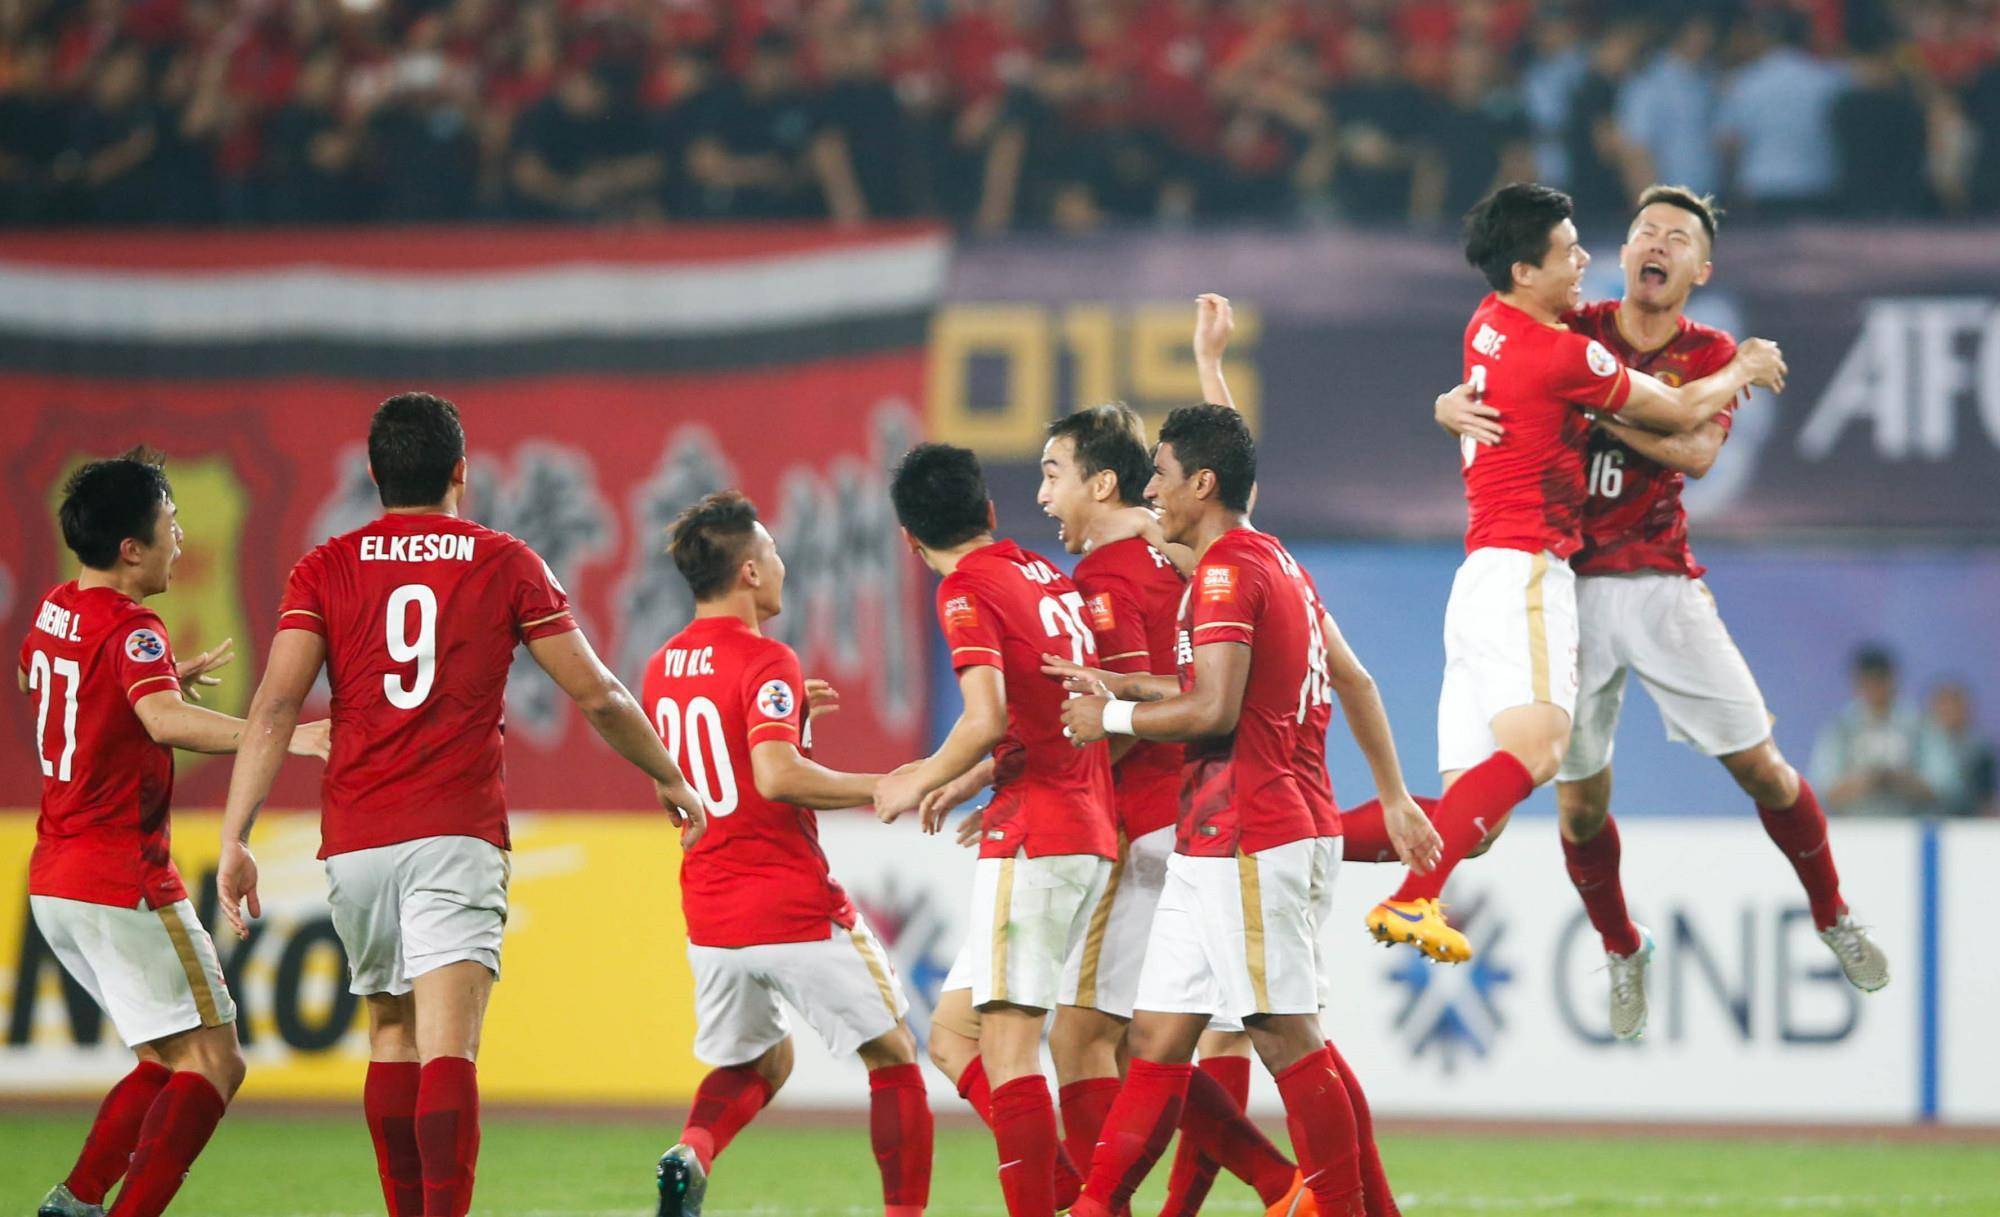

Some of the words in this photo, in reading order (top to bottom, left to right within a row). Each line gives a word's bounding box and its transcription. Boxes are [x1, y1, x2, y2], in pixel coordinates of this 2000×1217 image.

[1588, 450, 1624, 498] 16
[360, 533, 475, 562] ELKESON
[384, 584, 437, 709] 9
[665, 649, 687, 678] YU
[29, 650, 80, 781] 27
